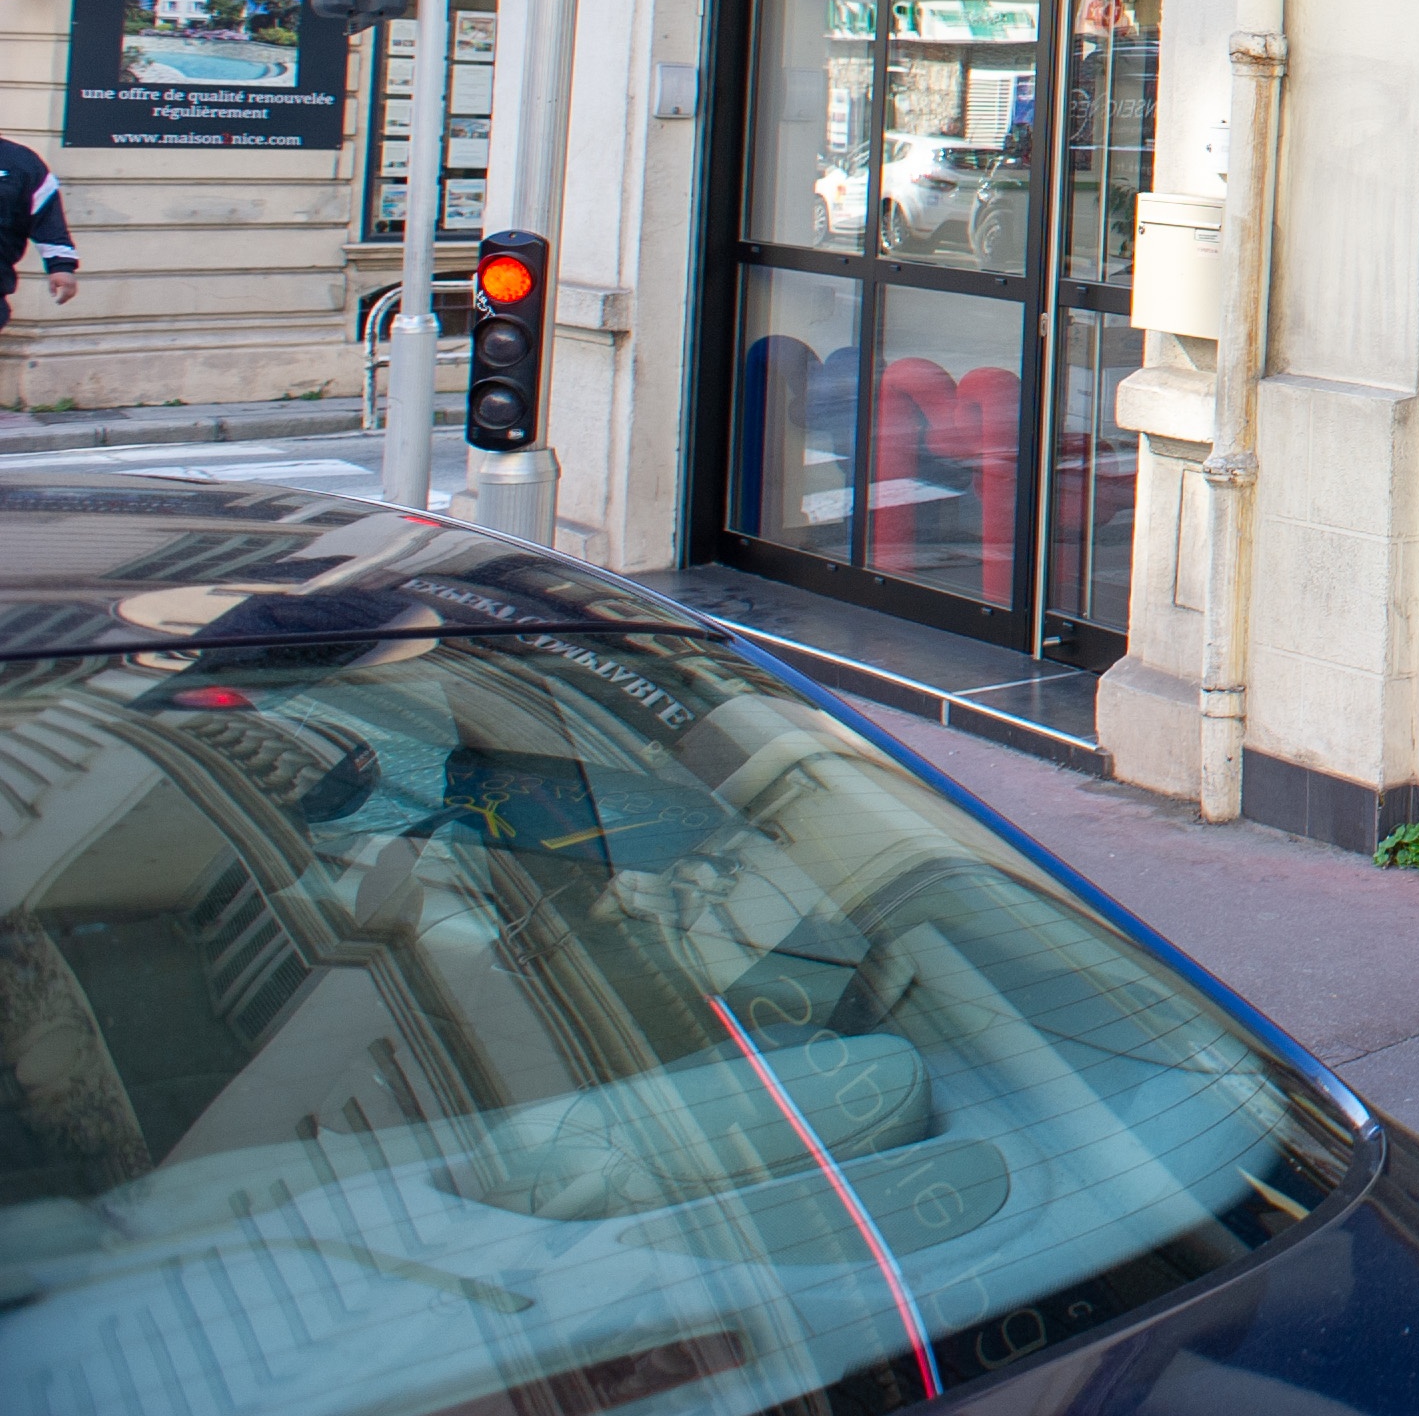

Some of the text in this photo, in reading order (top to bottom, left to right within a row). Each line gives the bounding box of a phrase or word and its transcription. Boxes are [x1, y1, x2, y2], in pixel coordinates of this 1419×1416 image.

[81, 86, 335, 105] une offre de qualité renouvelée
[152, 105, 270, 121] régulièrement
